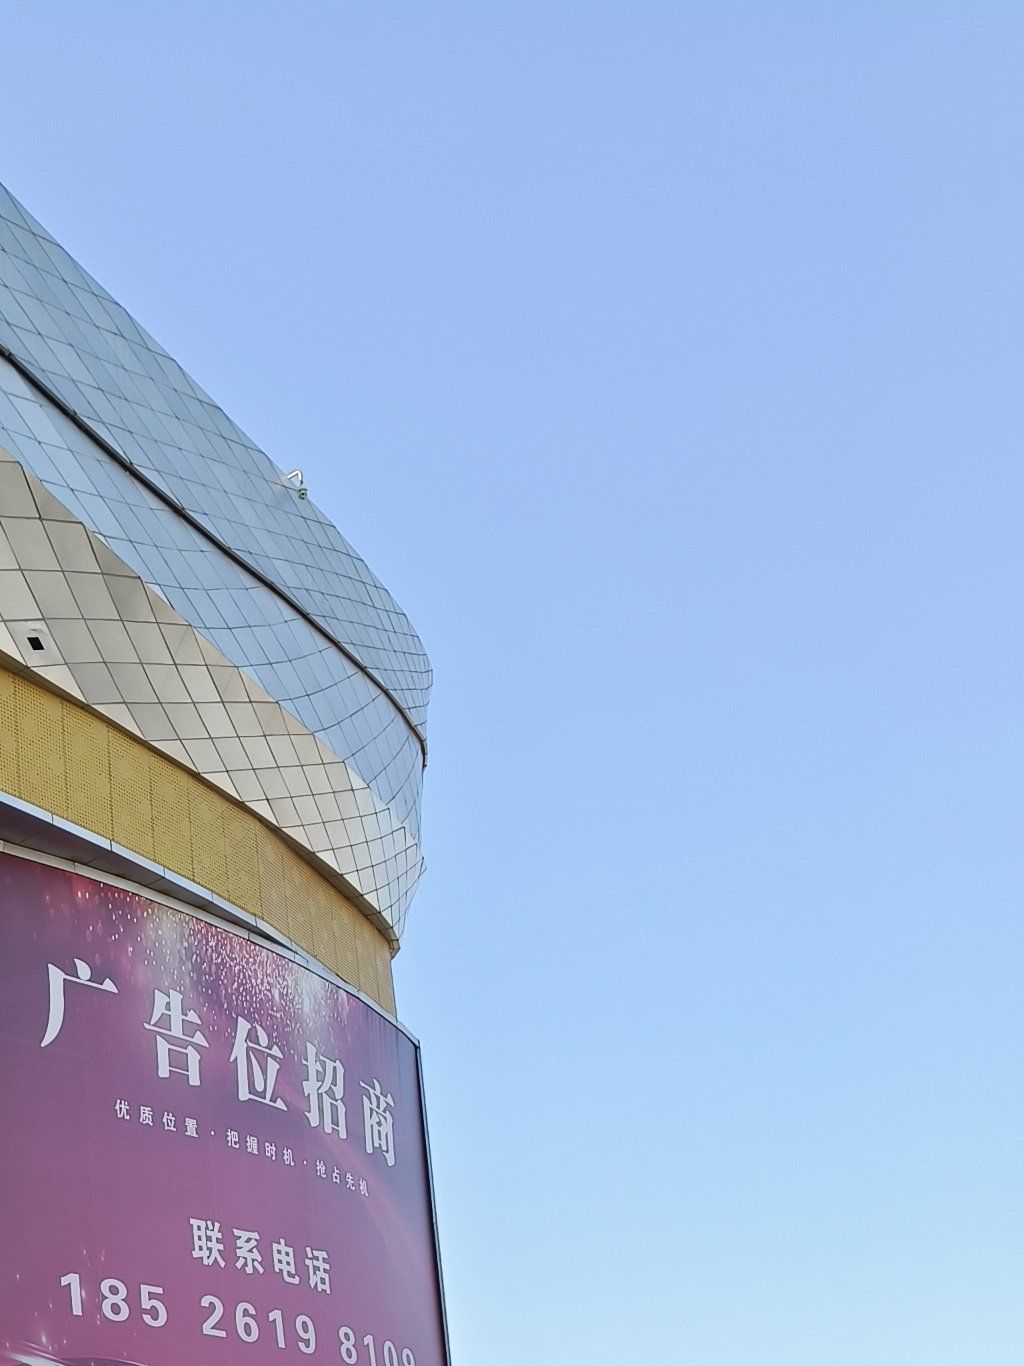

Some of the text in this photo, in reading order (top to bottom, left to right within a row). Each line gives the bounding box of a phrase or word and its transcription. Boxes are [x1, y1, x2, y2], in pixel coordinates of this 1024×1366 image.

[39, 957, 397, 1167] 广告位招商
[189, 1216, 332, 1295] 联系电话
[59, 1272, 169, 1328] 185
[200, 1295, 316, 1355] 2619
